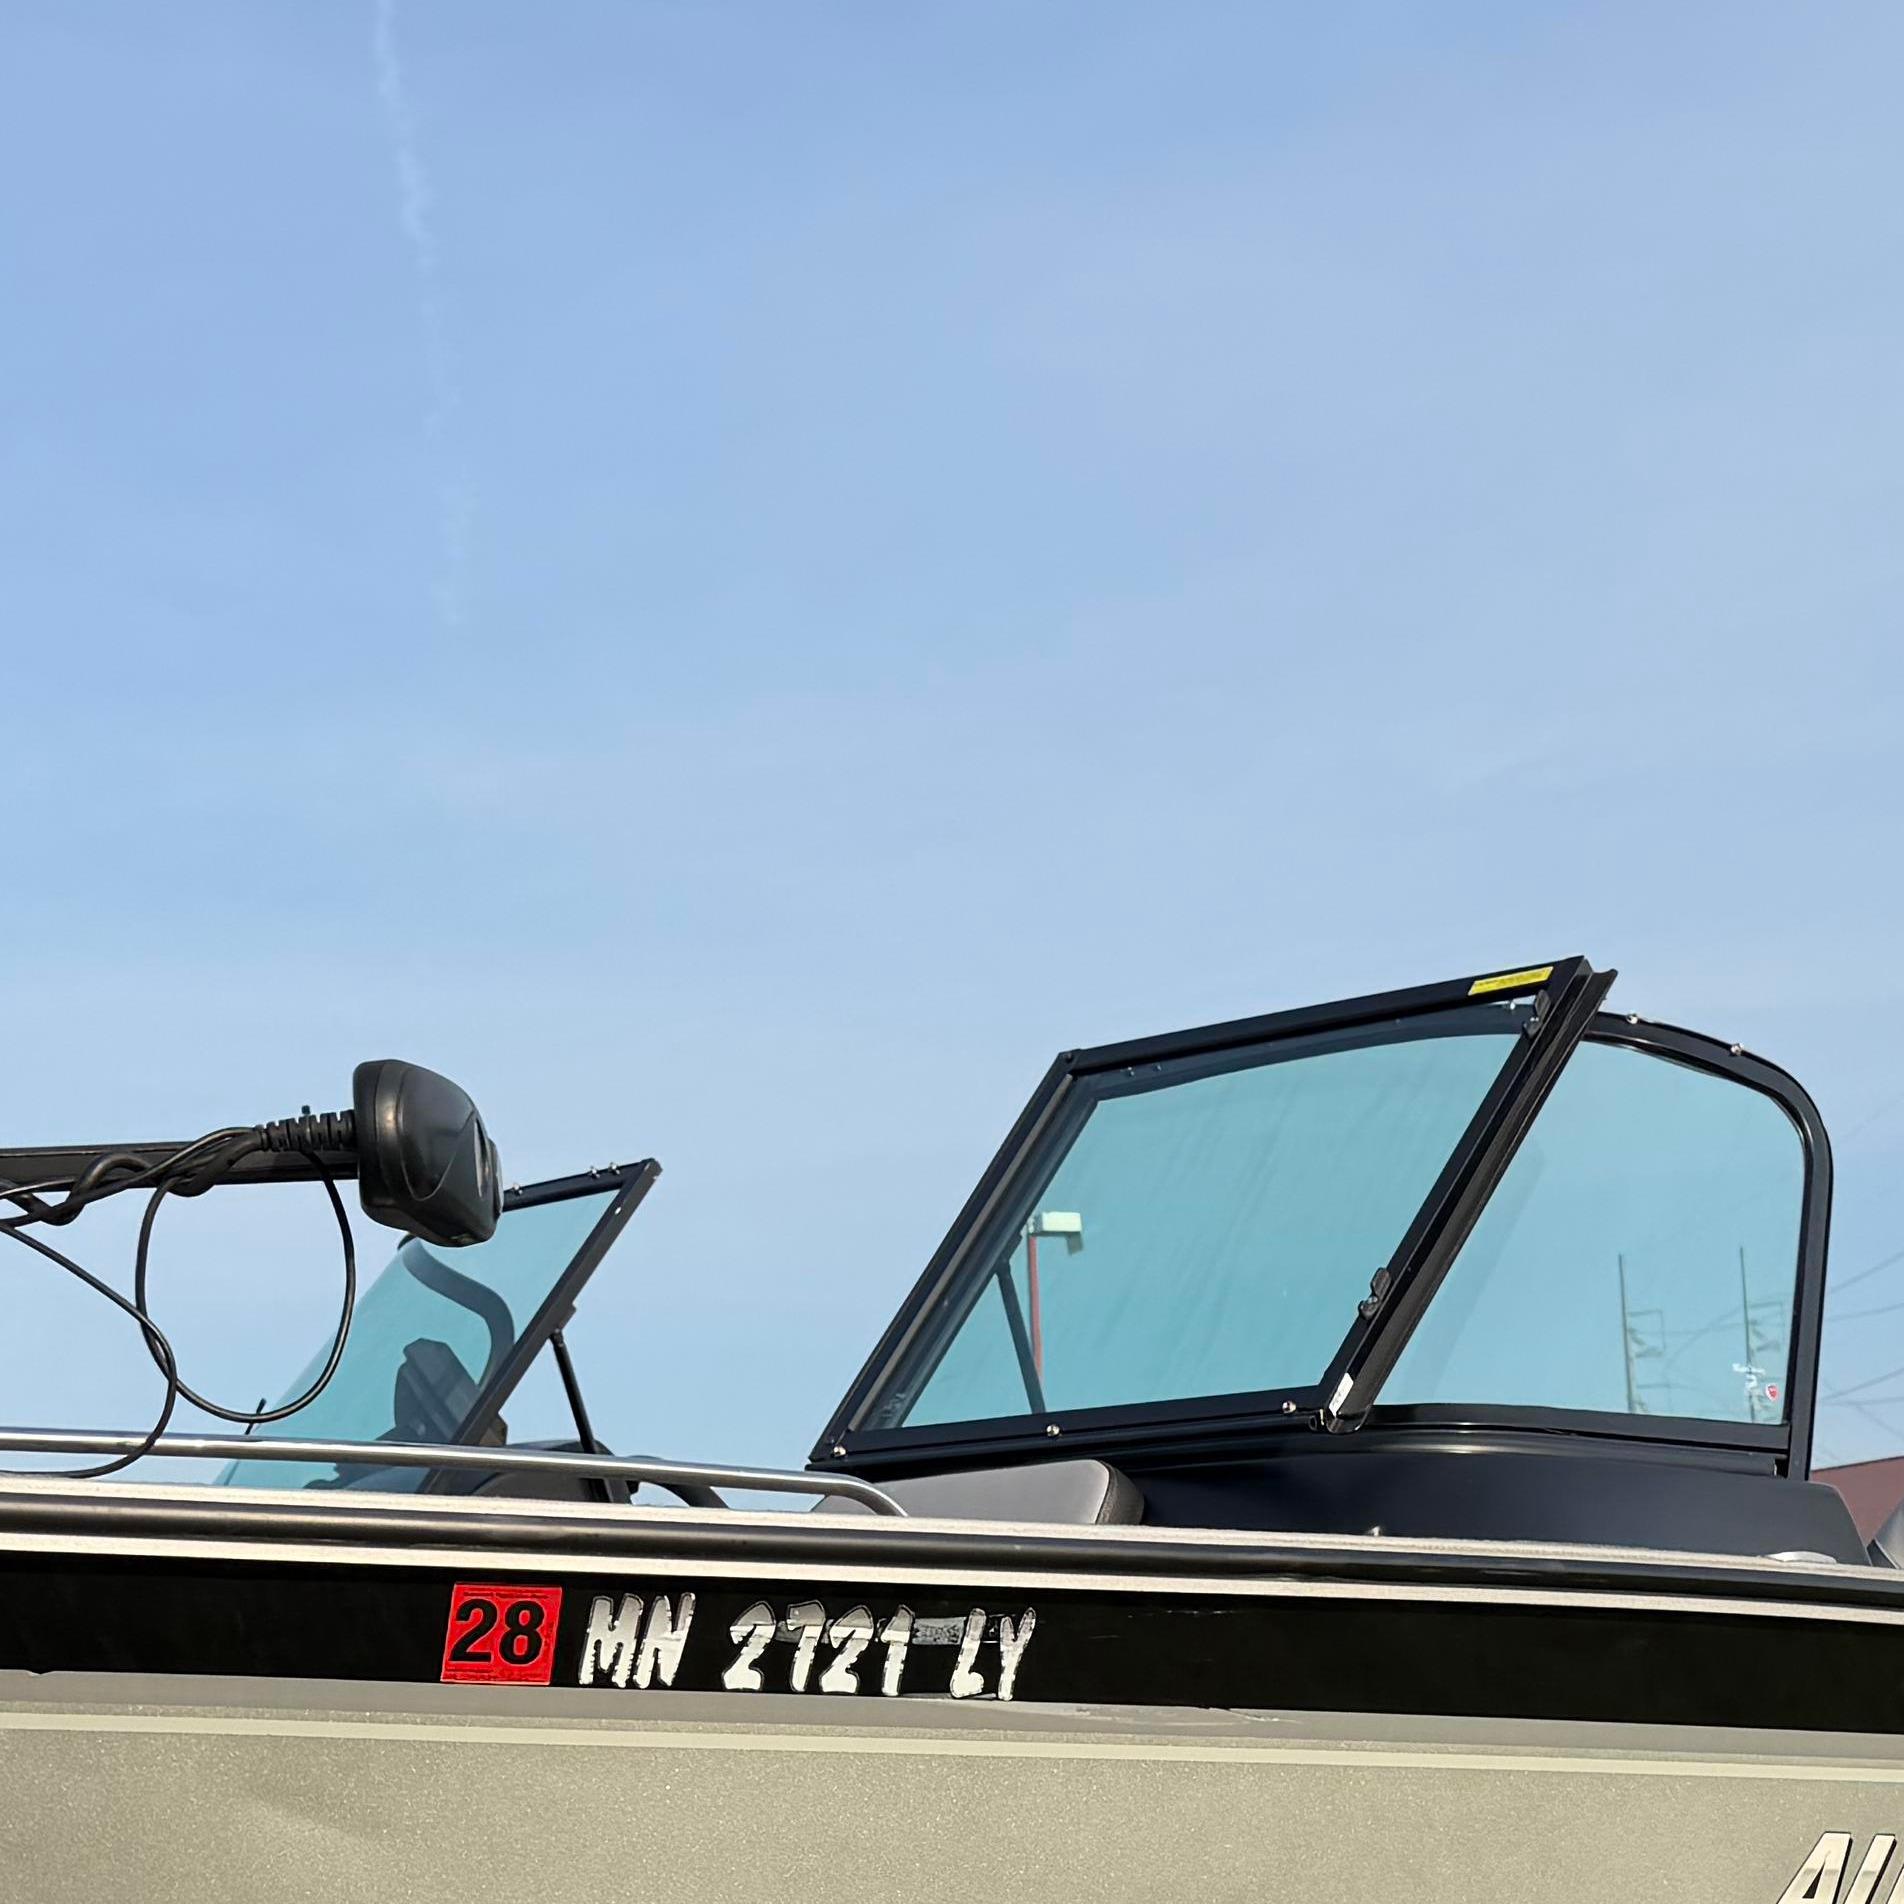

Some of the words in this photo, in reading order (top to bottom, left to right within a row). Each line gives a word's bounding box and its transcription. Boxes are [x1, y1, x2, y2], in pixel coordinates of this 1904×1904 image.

[449, 1598, 545, 1665] 28
[578, 1592, 696, 1688] MN
[722, 1600, 915, 1697] 2721
[950, 1606, 1036, 1701] LY
